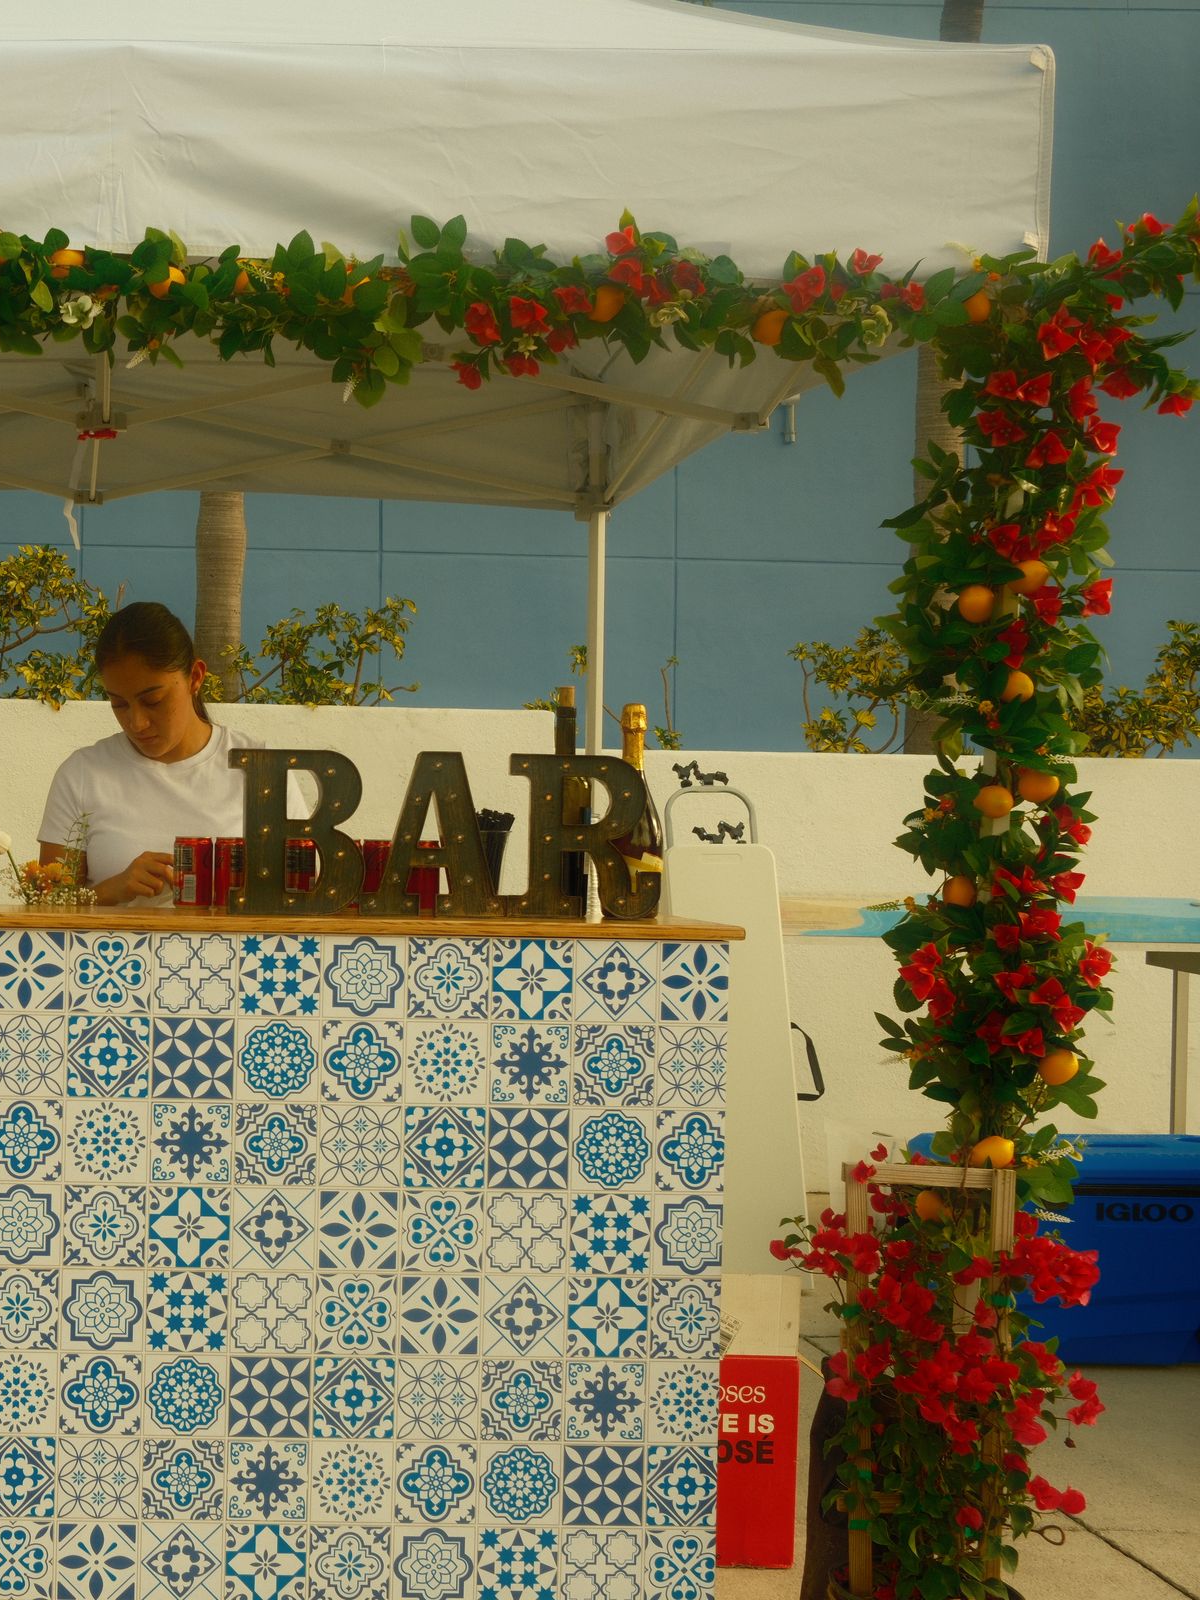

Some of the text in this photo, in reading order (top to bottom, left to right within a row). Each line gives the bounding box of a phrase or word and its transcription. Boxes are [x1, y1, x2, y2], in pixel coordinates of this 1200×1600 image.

[227, 748, 661, 920] BAR
[1096, 1203, 1194, 1222] IGLOO
[718, 1414, 775, 1434] E IS
[717, 1435, 775, 1465] OSÉ
